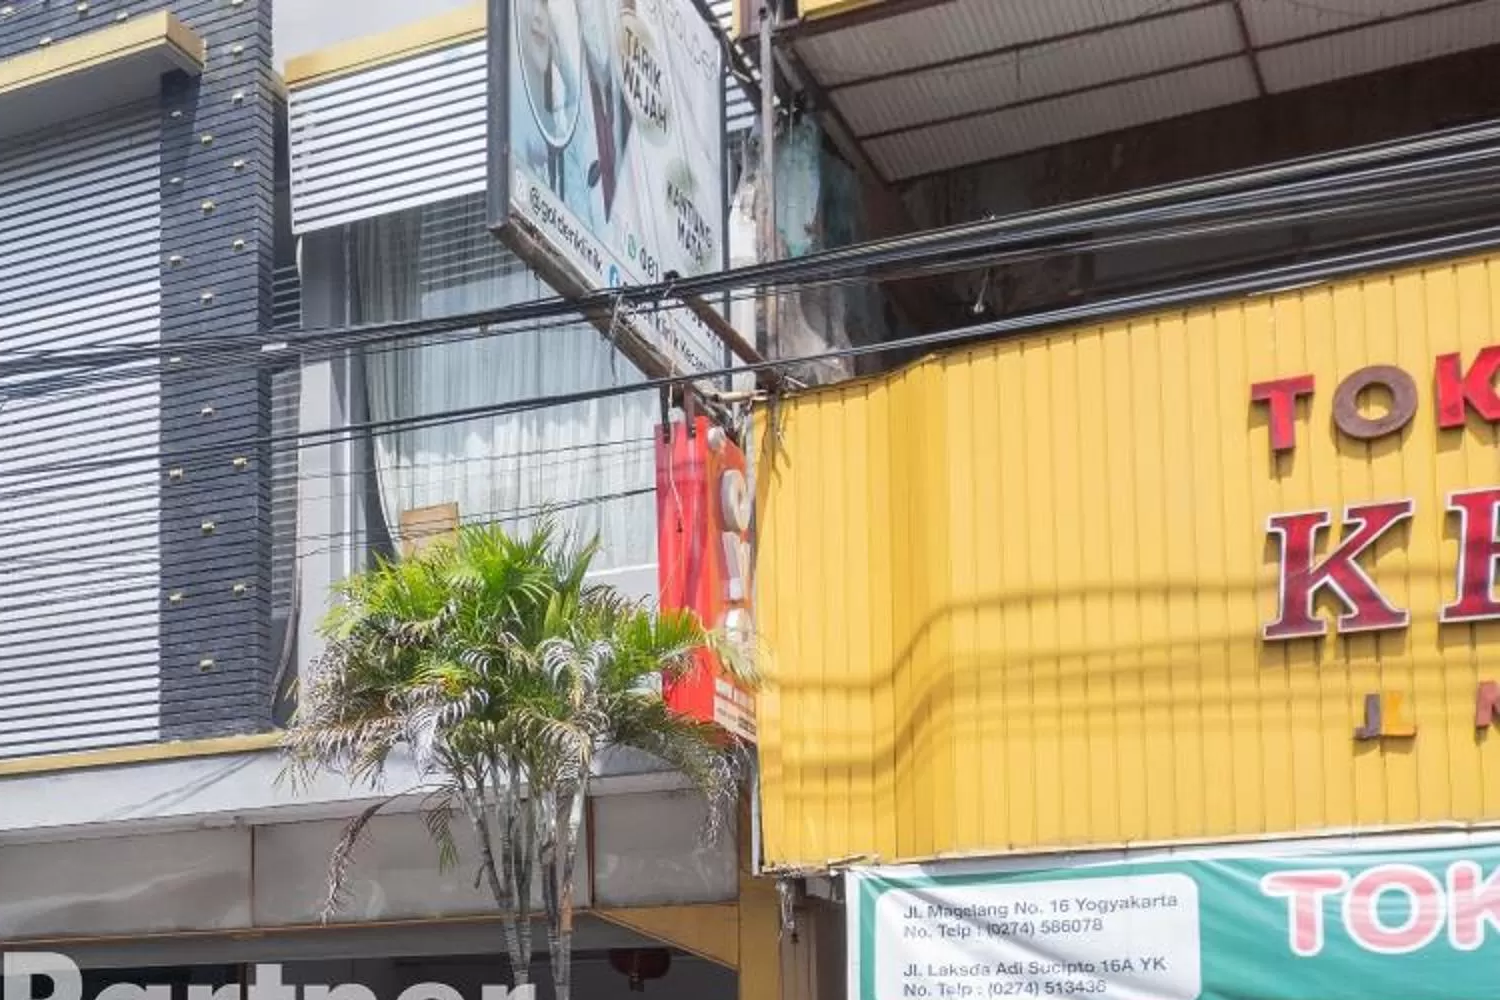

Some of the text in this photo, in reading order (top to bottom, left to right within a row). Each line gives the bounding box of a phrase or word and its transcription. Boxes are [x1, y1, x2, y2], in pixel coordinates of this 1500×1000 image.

[927, 903, 1009, 921] Magelang
[1014, 901, 1044, 914] No.
[1050, 899, 1070, 912] 16
[1076, 895, 1178, 914] Yogyakarta
[904, 925, 932, 938] No.
[987, 920, 1035, 938] (0274)
[1040, 918, 1103, 934] 586078
[927, 963, 990, 977] Laksda
[996, 961, 1023, 975] Adi
[1028, 960, 1096, 976] Sucipto
[1100, 959, 1134, 973] 16A
[1140, 956, 1168, 971] YK
[904, 983, 932, 997] No.
[987, 981, 1040, 998] (0274)
